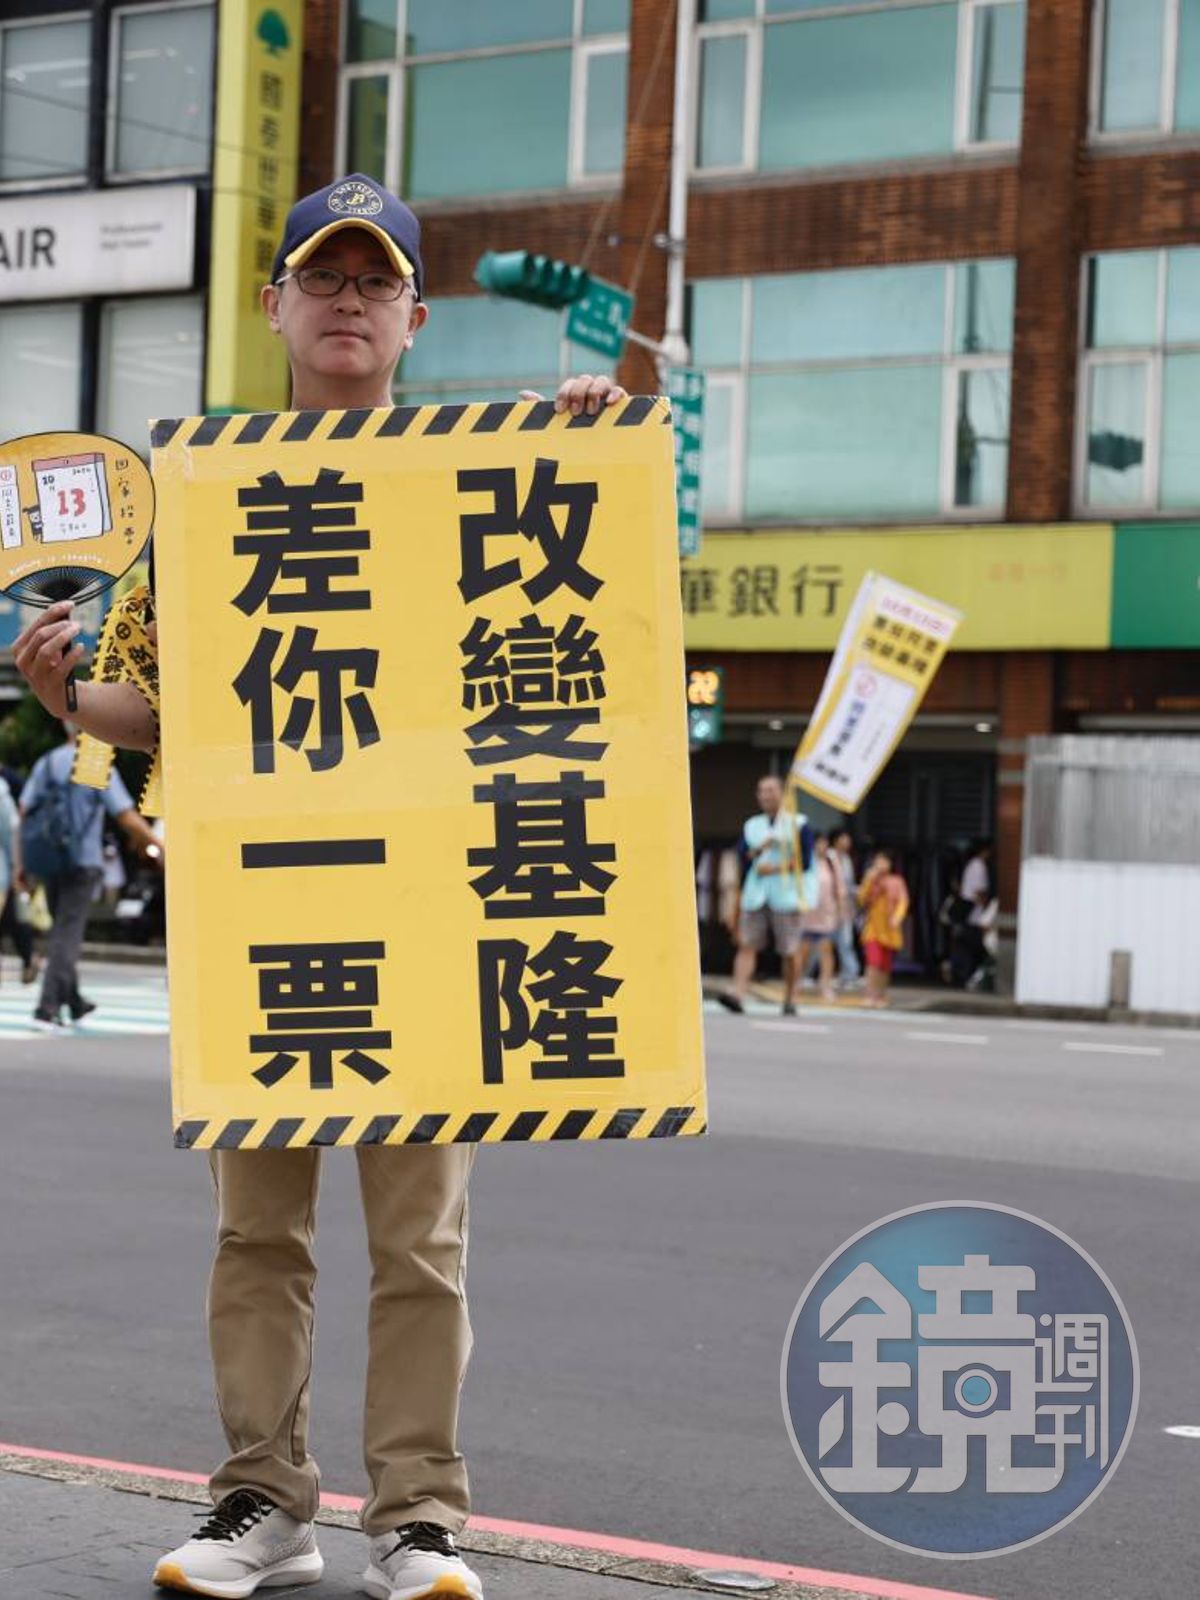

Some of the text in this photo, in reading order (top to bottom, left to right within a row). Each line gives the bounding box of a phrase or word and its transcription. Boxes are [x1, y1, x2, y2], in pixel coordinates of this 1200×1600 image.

[42, 475, 55, 485] 10
[57, 487, 87, 518] 13
[230, 466, 394, 1090] 差你一票
[456, 457, 626, 1085] 改變基隆
